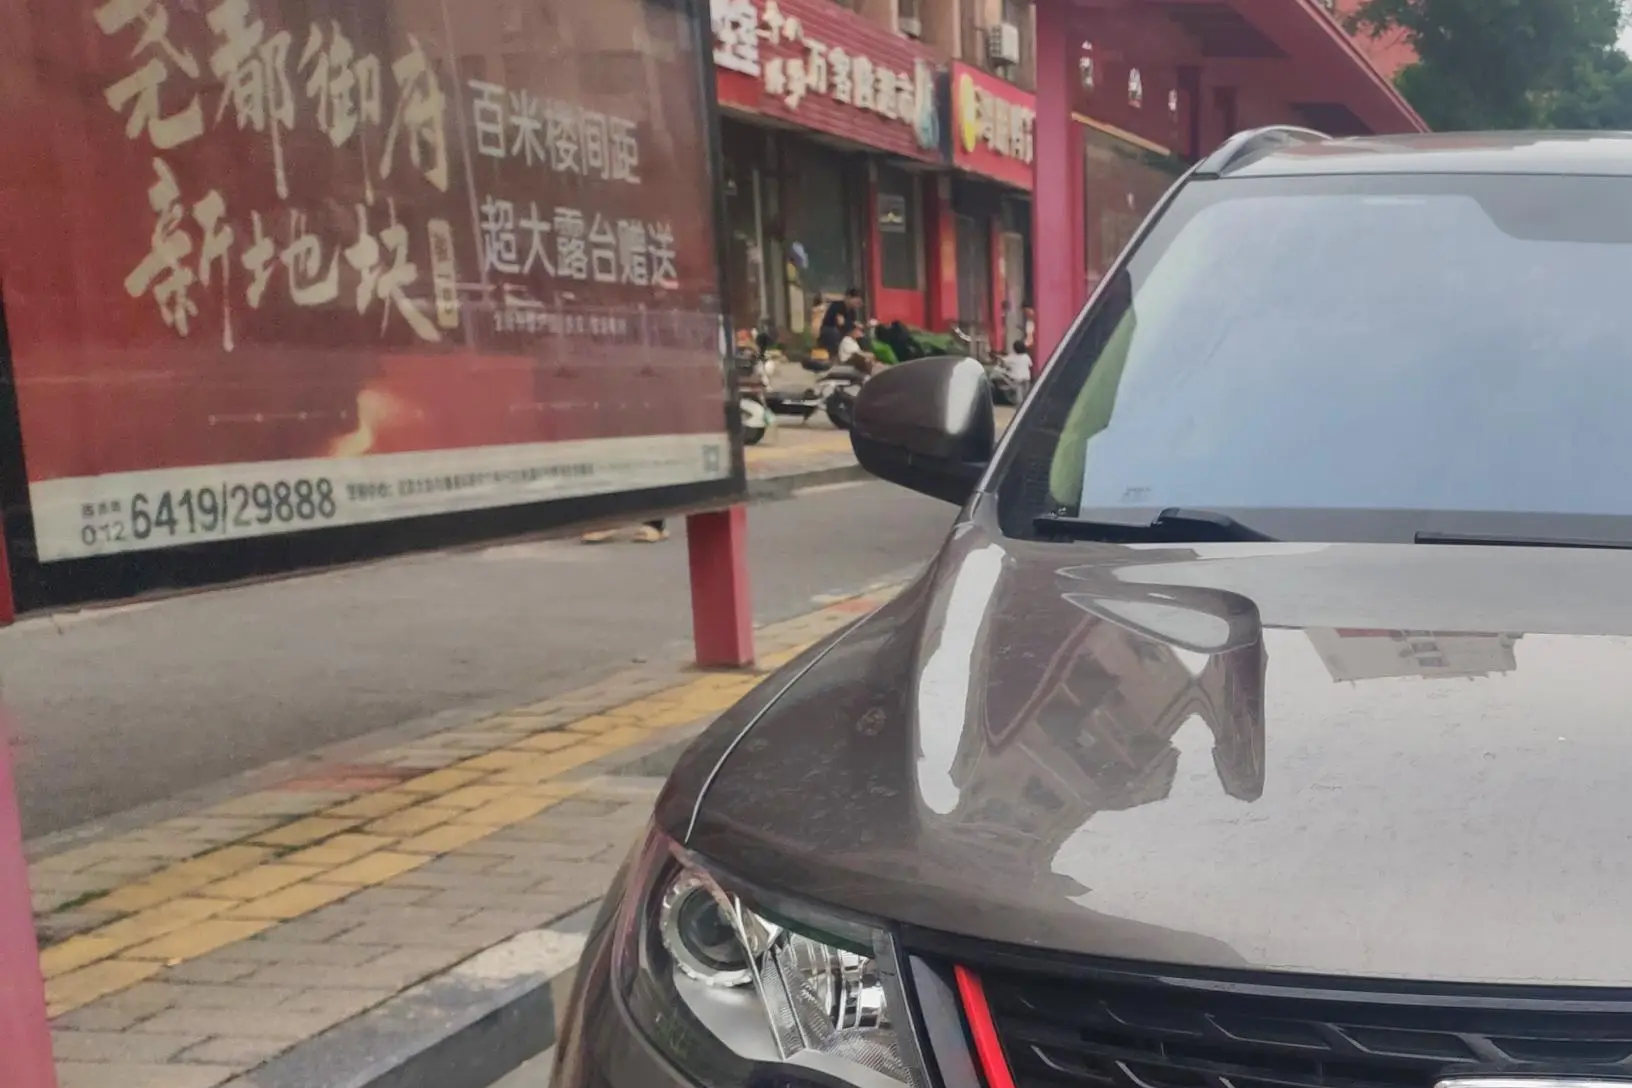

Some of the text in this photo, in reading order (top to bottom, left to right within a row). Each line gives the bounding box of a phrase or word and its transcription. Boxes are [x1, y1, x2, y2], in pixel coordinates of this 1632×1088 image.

[467, 79, 642, 184] 百米楼间距
[124, 156, 441, 352] 新地块
[480, 193, 679, 289] 超大露台赠送
